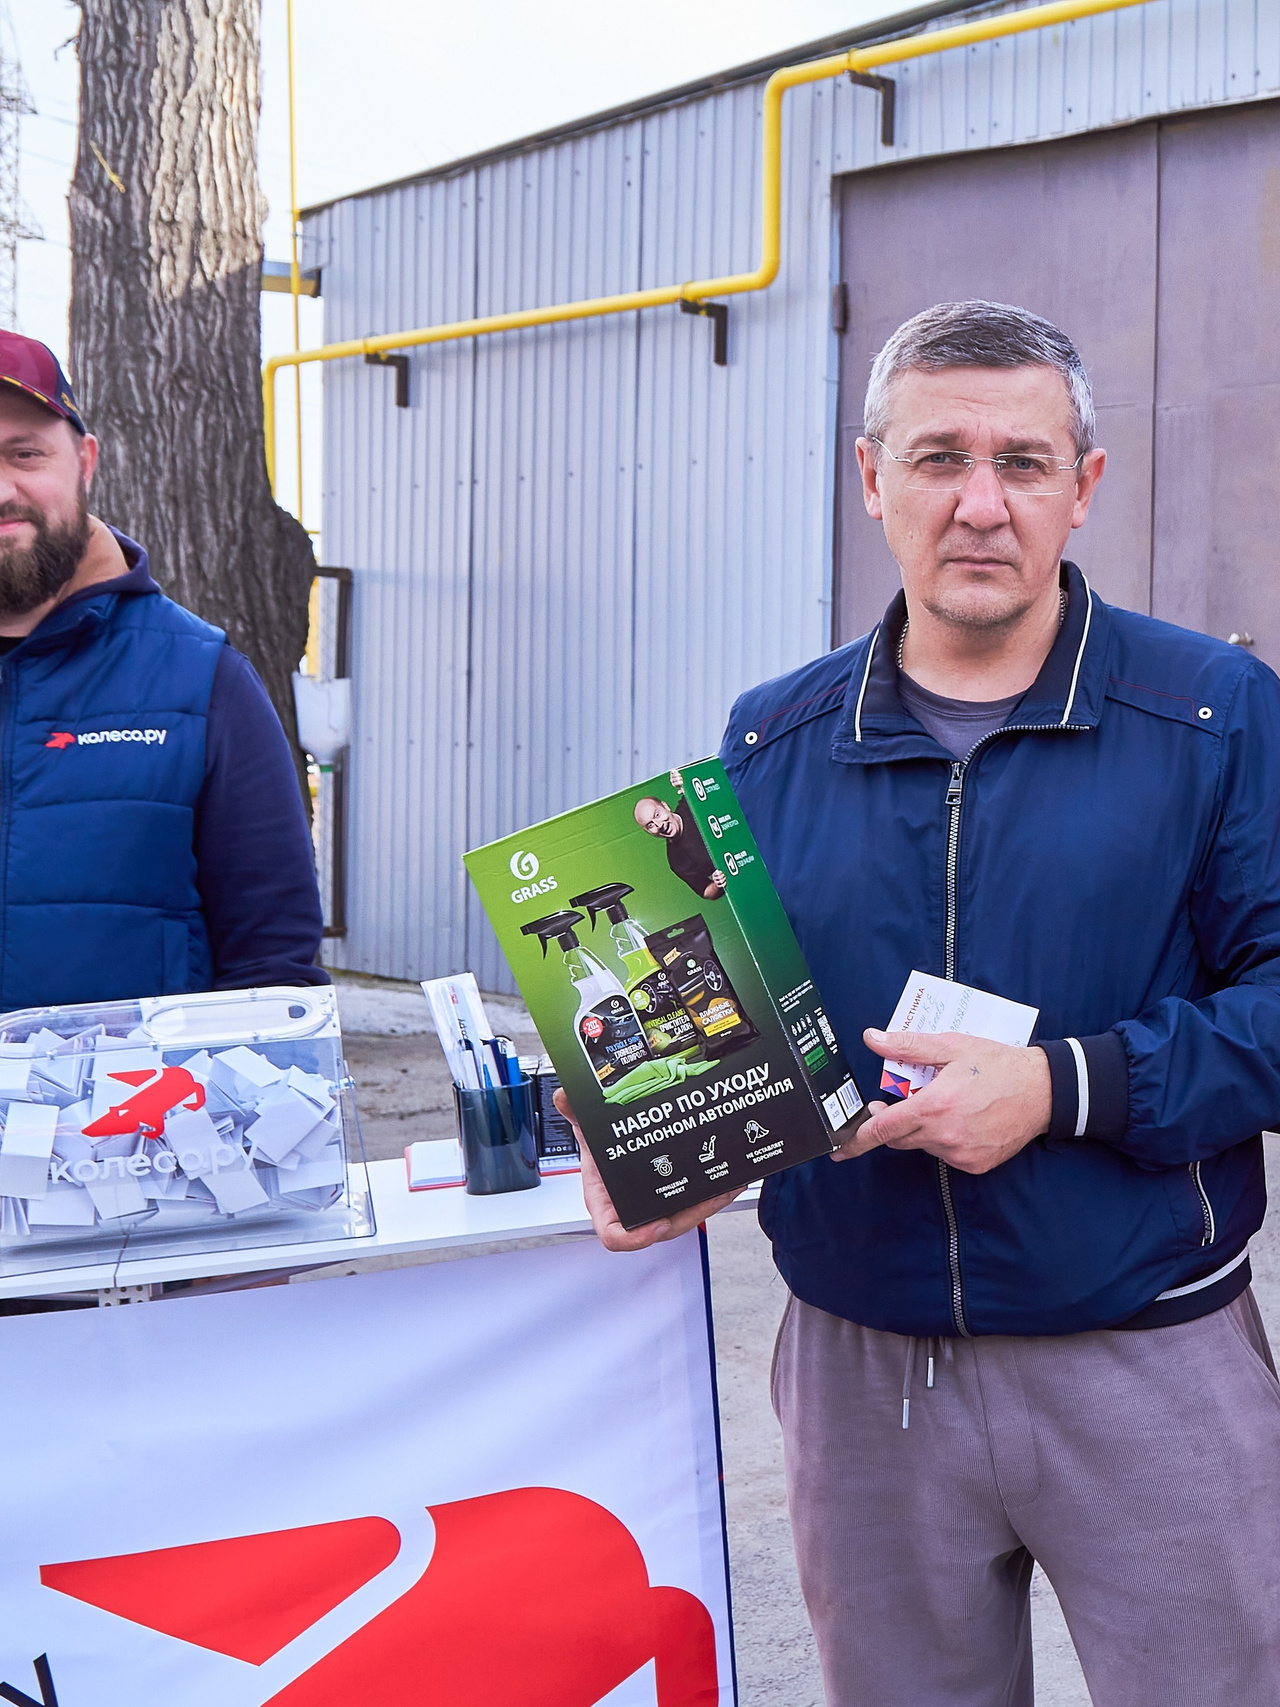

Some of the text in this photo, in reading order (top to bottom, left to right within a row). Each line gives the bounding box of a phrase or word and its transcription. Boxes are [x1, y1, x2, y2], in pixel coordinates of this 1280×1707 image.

[78, 729, 167, 745] колесо.ру
[511, 876, 558, 904] GRASS
[901, 987, 925, 1031] ЧАСТНИКА
[611, 1102, 674, 1138] НАБОР
[676, 1091, 706, 1114] ПО
[706, 1062, 770, 1100] УХОДУ
[606, 1144, 627, 1160] ЗА
[626, 1117, 696, 1153] САЛОНОМ
[699, 1078, 794, 1126] АВТОМОБИЛЯ
[754, 1140, 785, 1156] ОСТАВЛЯЕТ
[51, 1141, 257, 1185] колесо.ру
[753, 1149, 783, 1164] ВОРСИНОК
[704, 1161, 729, 1175] ЧИСТЫЙ
[709, 1169, 729, 1180] САЛОН
[655, 1177, 689, 1194] ГЛЯНЦЕВЫЙ
[664, 1186, 686, 1199] ЭФФЕКТ
